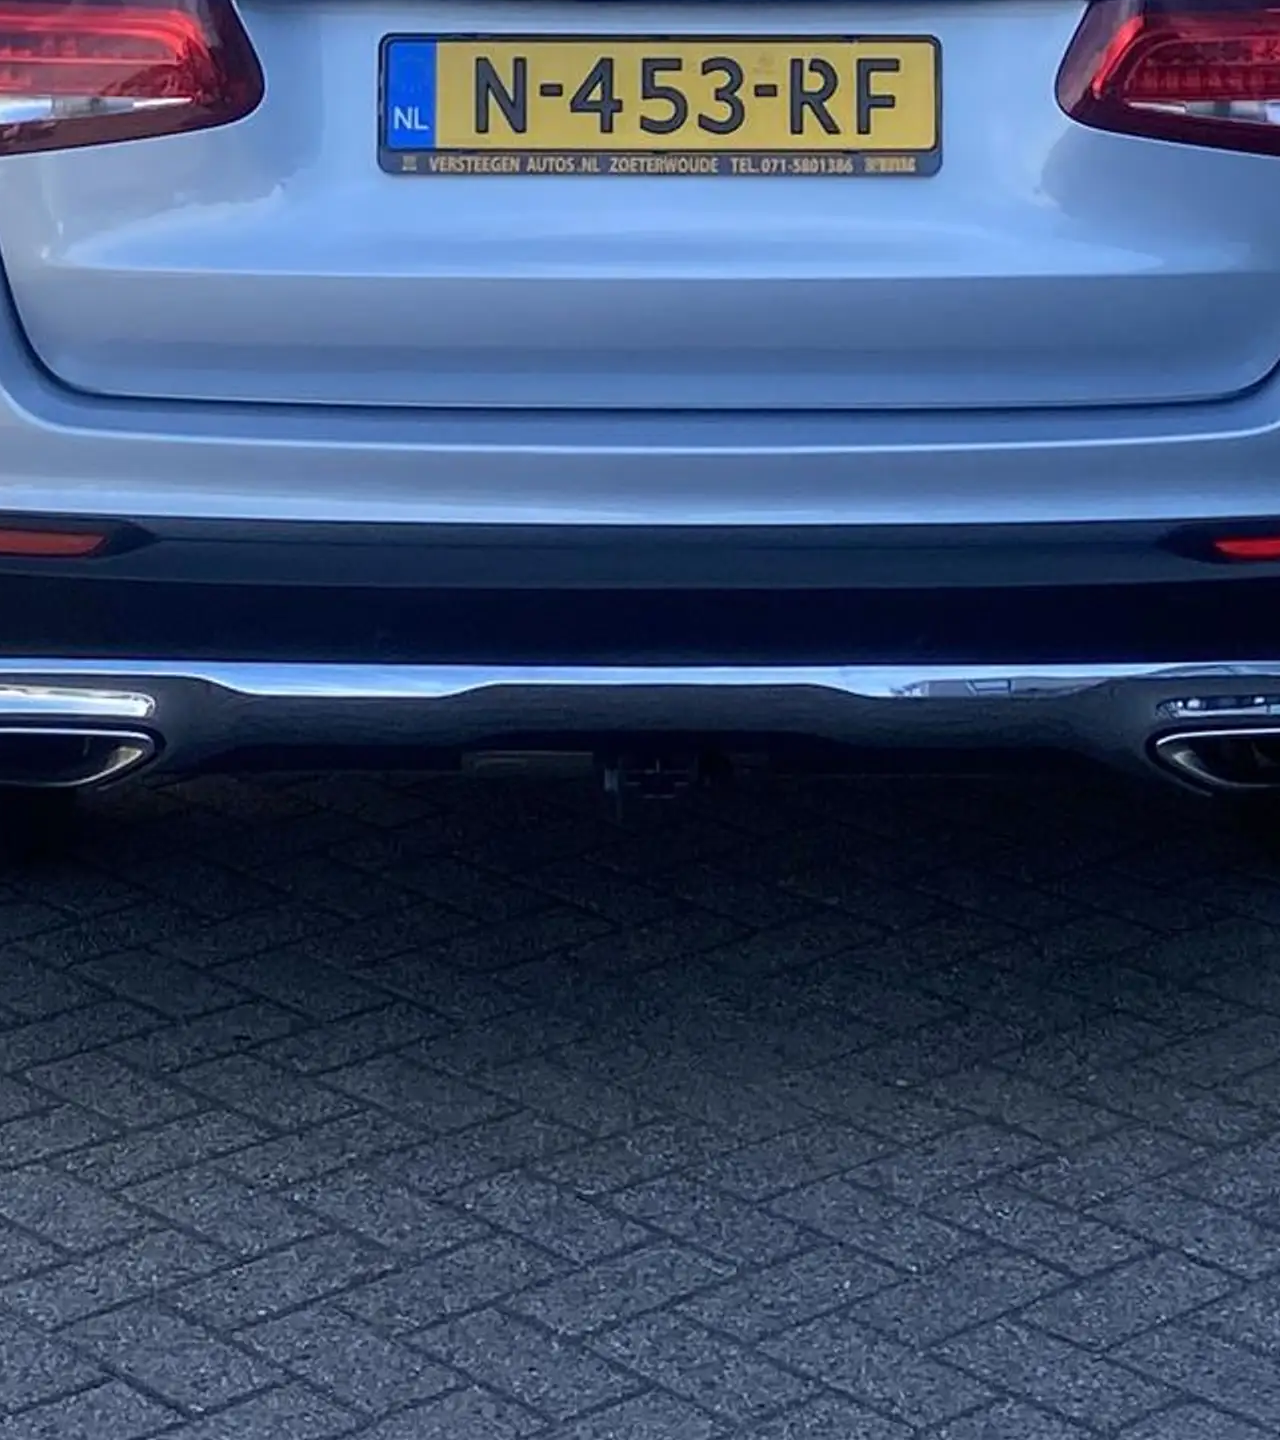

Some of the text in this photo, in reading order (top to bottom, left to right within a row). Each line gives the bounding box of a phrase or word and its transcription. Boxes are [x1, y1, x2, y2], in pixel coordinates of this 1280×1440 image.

[474, 56, 901, 135] N-453-RF
[393, 106, 429, 131] NL
[429, 156, 520, 172] VERSTEEGEN
[526, 156, 600, 173] AUTOS.NL
[608, 156, 718, 173] ZOETERWOUDE
